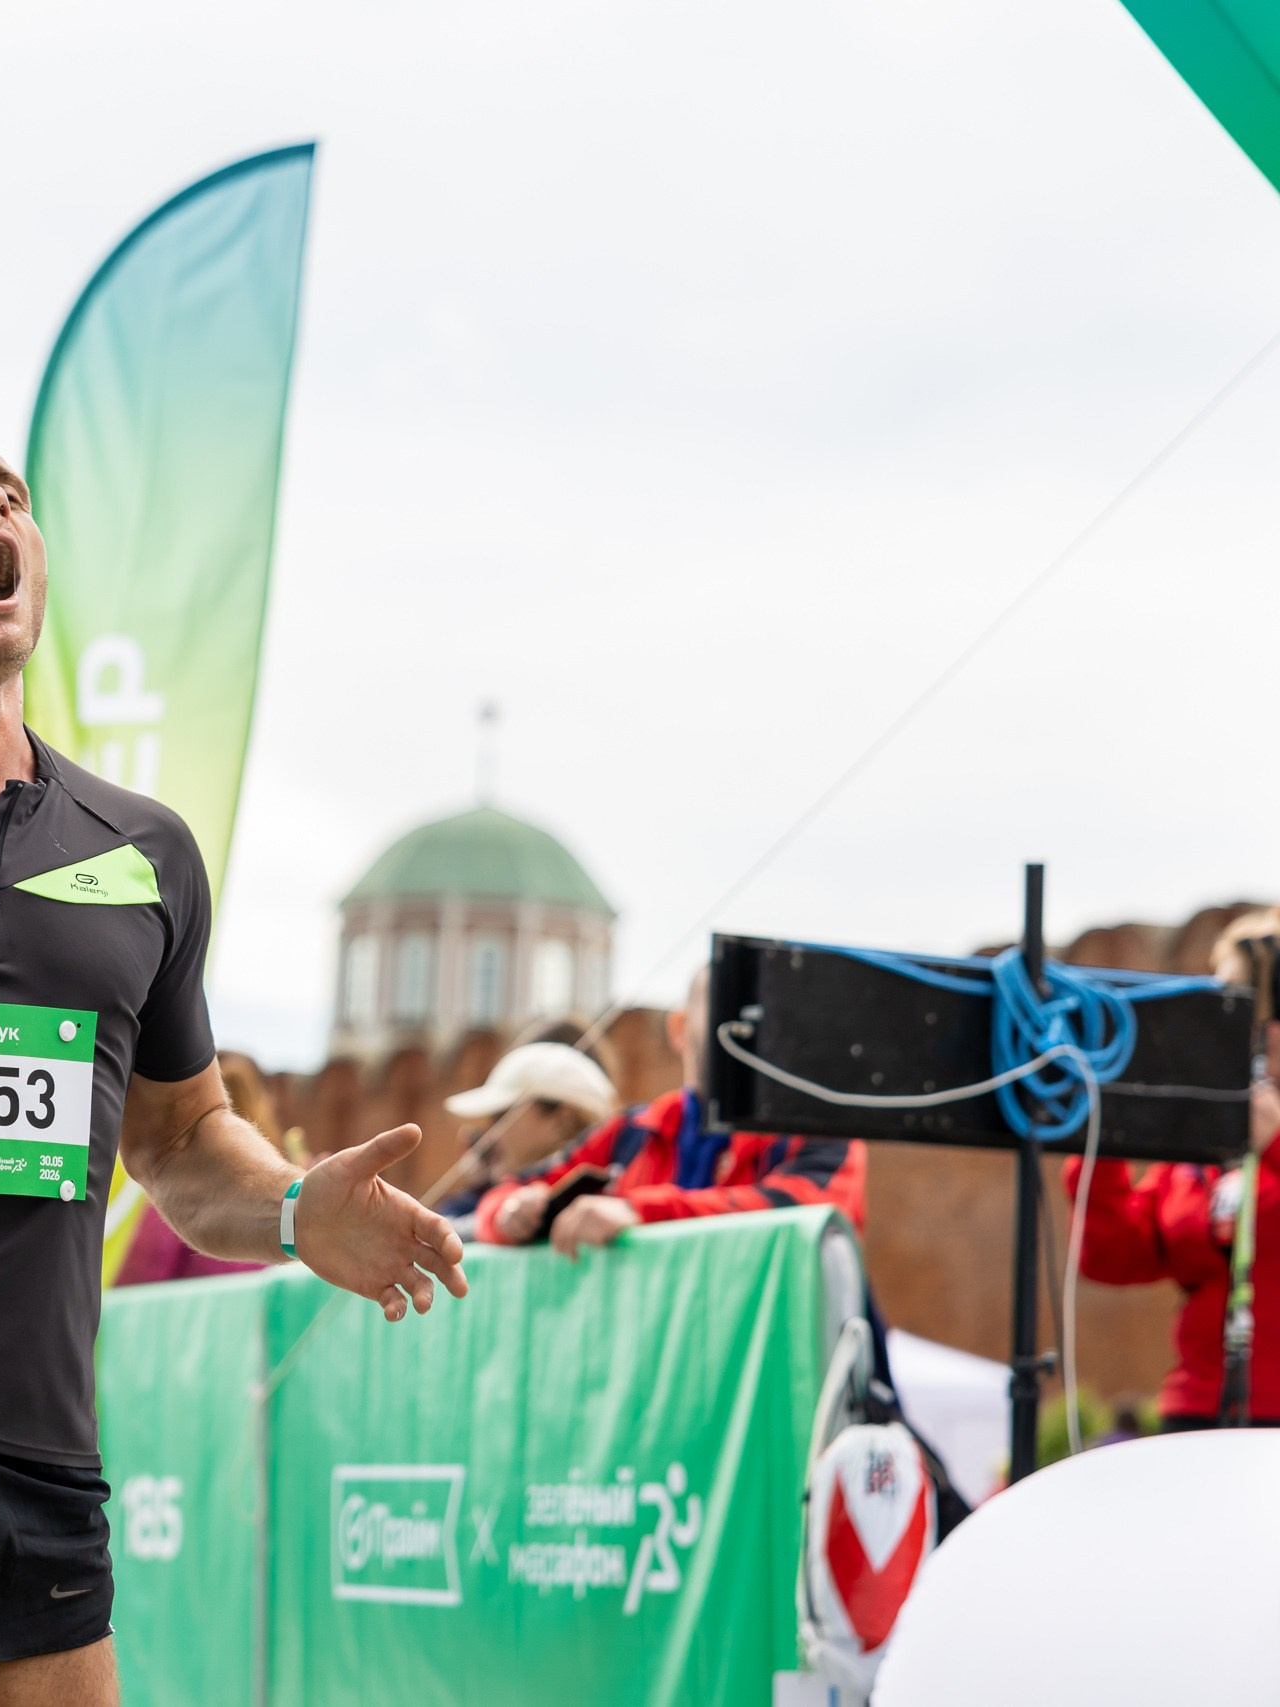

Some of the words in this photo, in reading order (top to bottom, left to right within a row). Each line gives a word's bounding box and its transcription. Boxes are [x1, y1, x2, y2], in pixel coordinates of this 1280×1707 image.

[70, 883, 108, 897] Kalenji
[39, 1155, 63, 1167] 30.05
[39, 1168, 60, 1181] 2026
